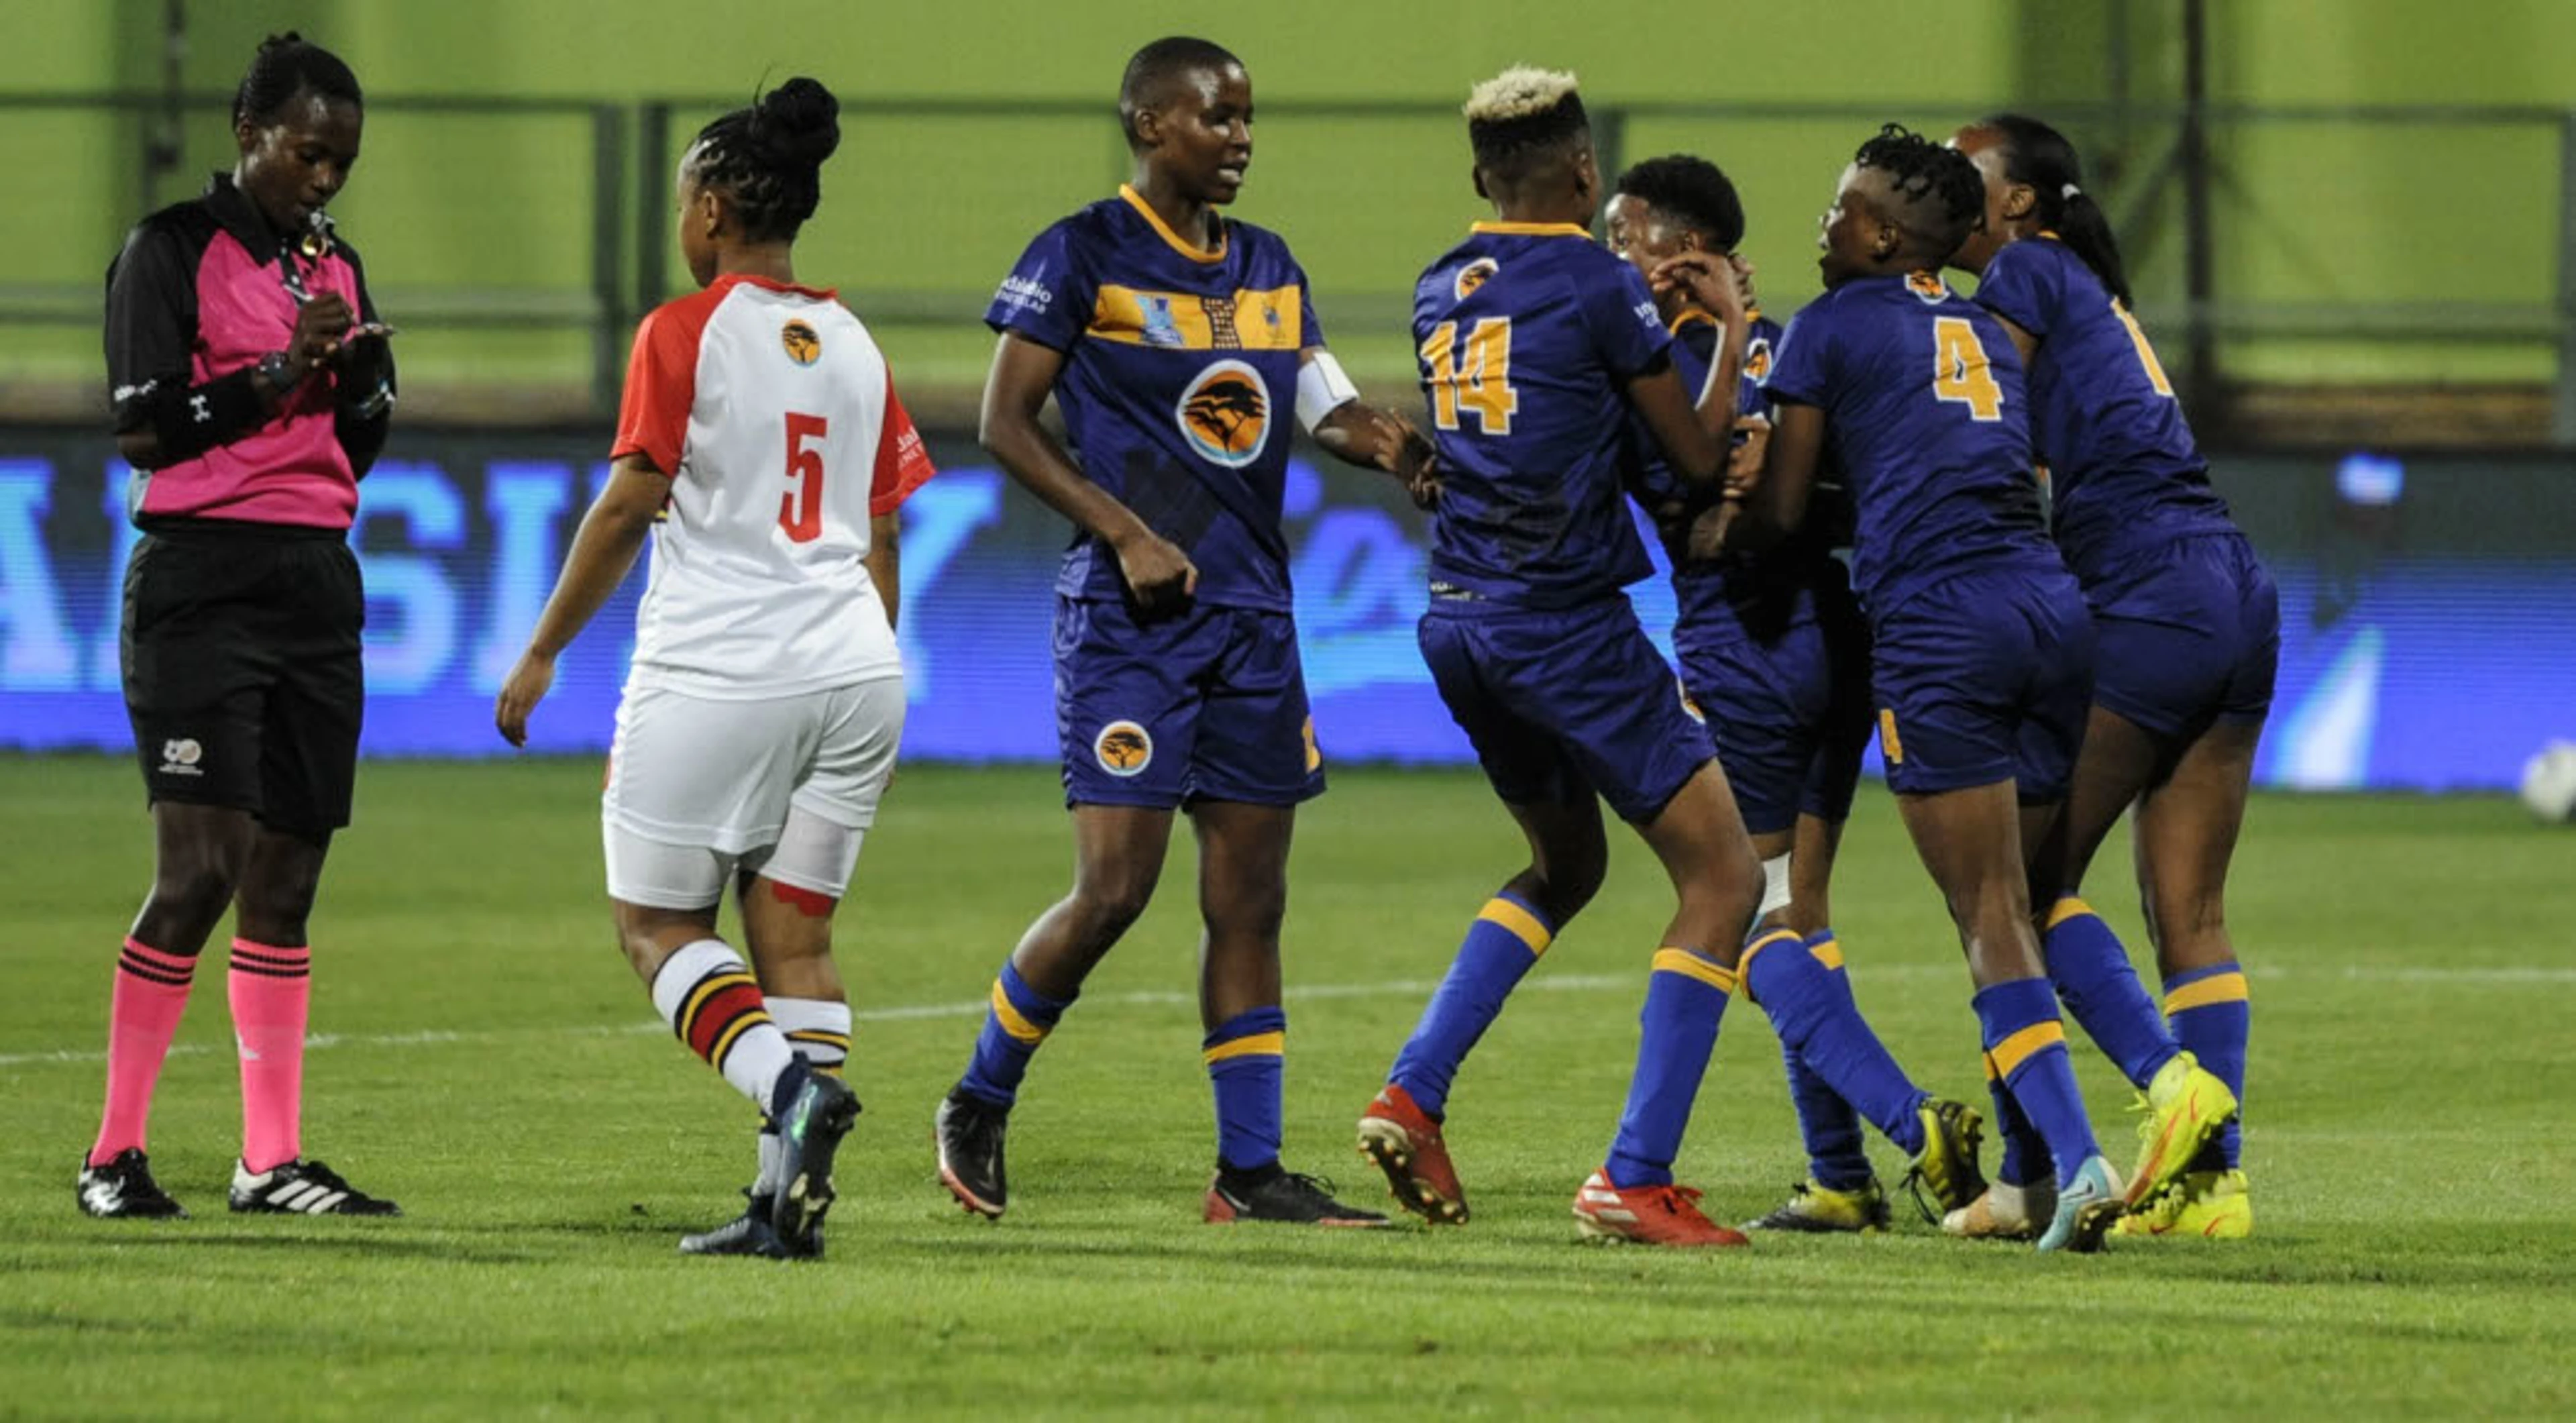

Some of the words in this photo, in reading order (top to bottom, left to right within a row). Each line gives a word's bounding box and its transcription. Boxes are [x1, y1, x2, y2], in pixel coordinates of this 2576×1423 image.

[1419, 316, 1517, 435] 14
[1932, 315, 2004, 422] 4
[777, 411, 828, 544] 5
